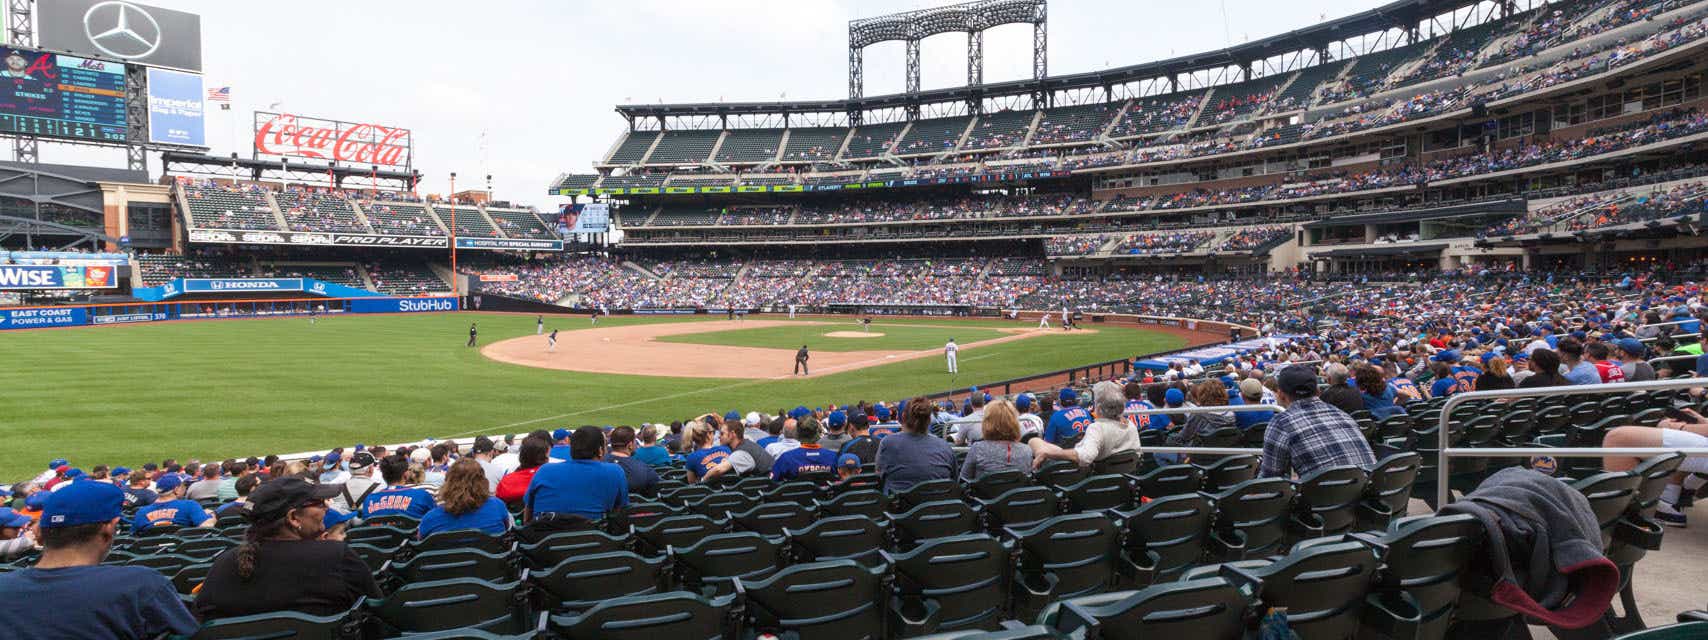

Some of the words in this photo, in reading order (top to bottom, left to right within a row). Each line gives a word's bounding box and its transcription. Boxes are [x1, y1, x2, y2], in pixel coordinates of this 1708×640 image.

[334, 235, 375, 244] PRO
[375, 236, 446, 246] PLAYER
[0, 267, 57, 287] WISE
[400, 300, 452, 311] StubHub
[11, 309, 38, 318] EAST
[39, 309, 72, 317] COAST
[11, 317, 46, 325] POWER
